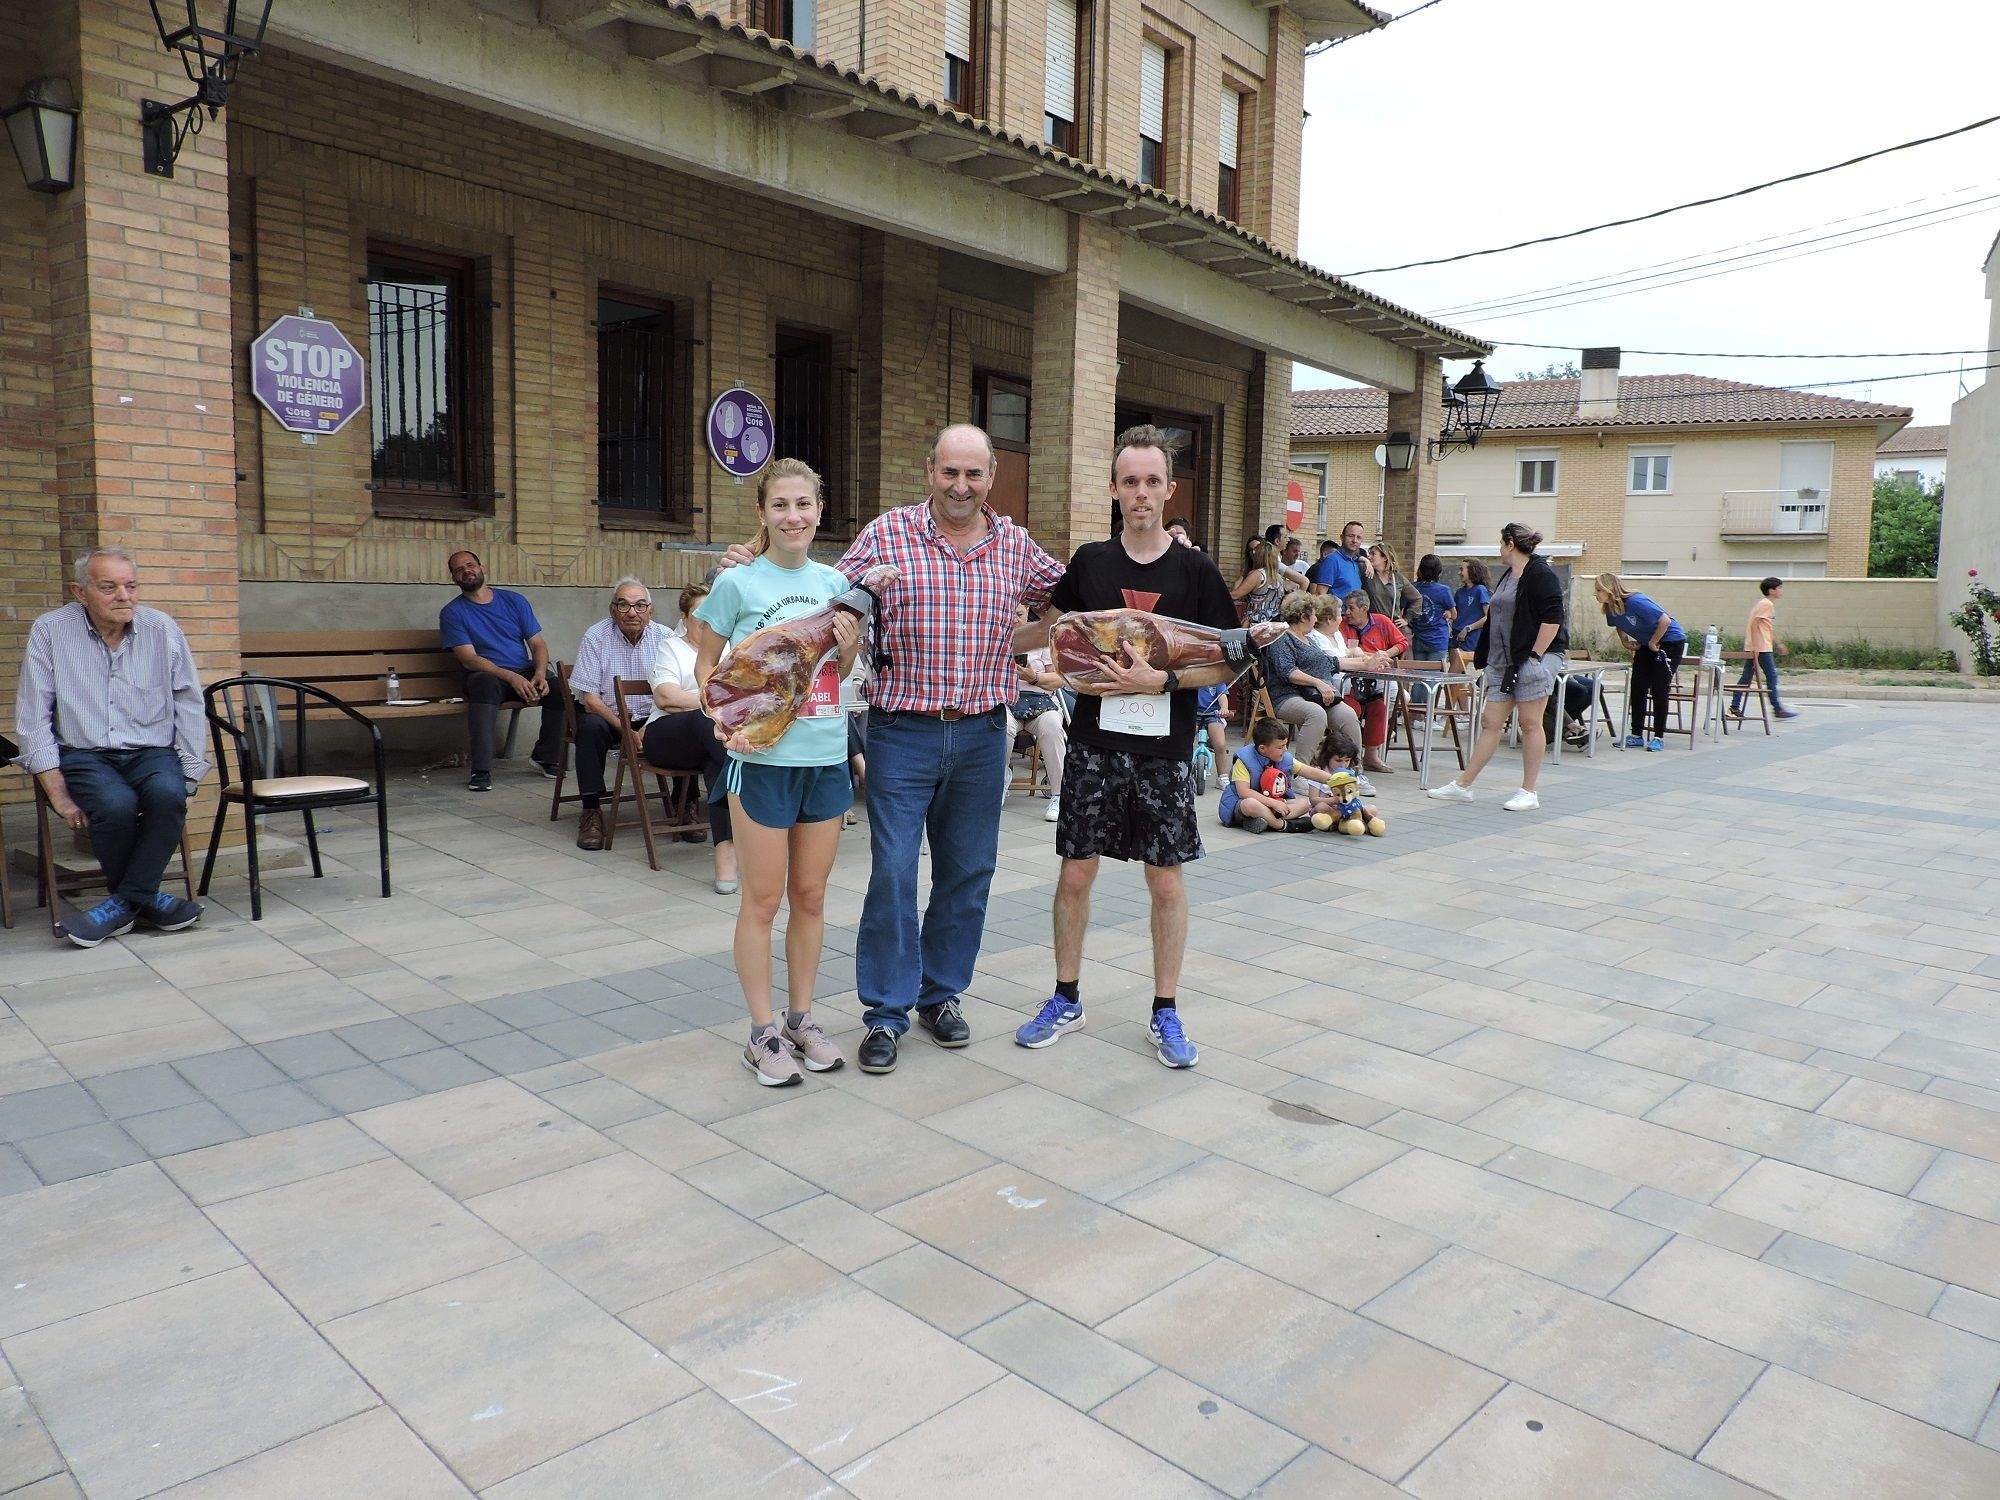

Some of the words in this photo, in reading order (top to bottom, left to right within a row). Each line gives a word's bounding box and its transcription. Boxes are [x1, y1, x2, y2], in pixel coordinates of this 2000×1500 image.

[265, 338, 352, 379] STOP
[276, 374, 342, 394] VIOLENCIA
[277, 390, 294, 403] DE
[296, 391, 343, 409] GÉNERO
[762, 602, 783, 621] MILLA
[781, 595, 810, 606] URBANA
[807, 692, 832, 702] ABEL
[1119, 699, 1155, 718] 200
